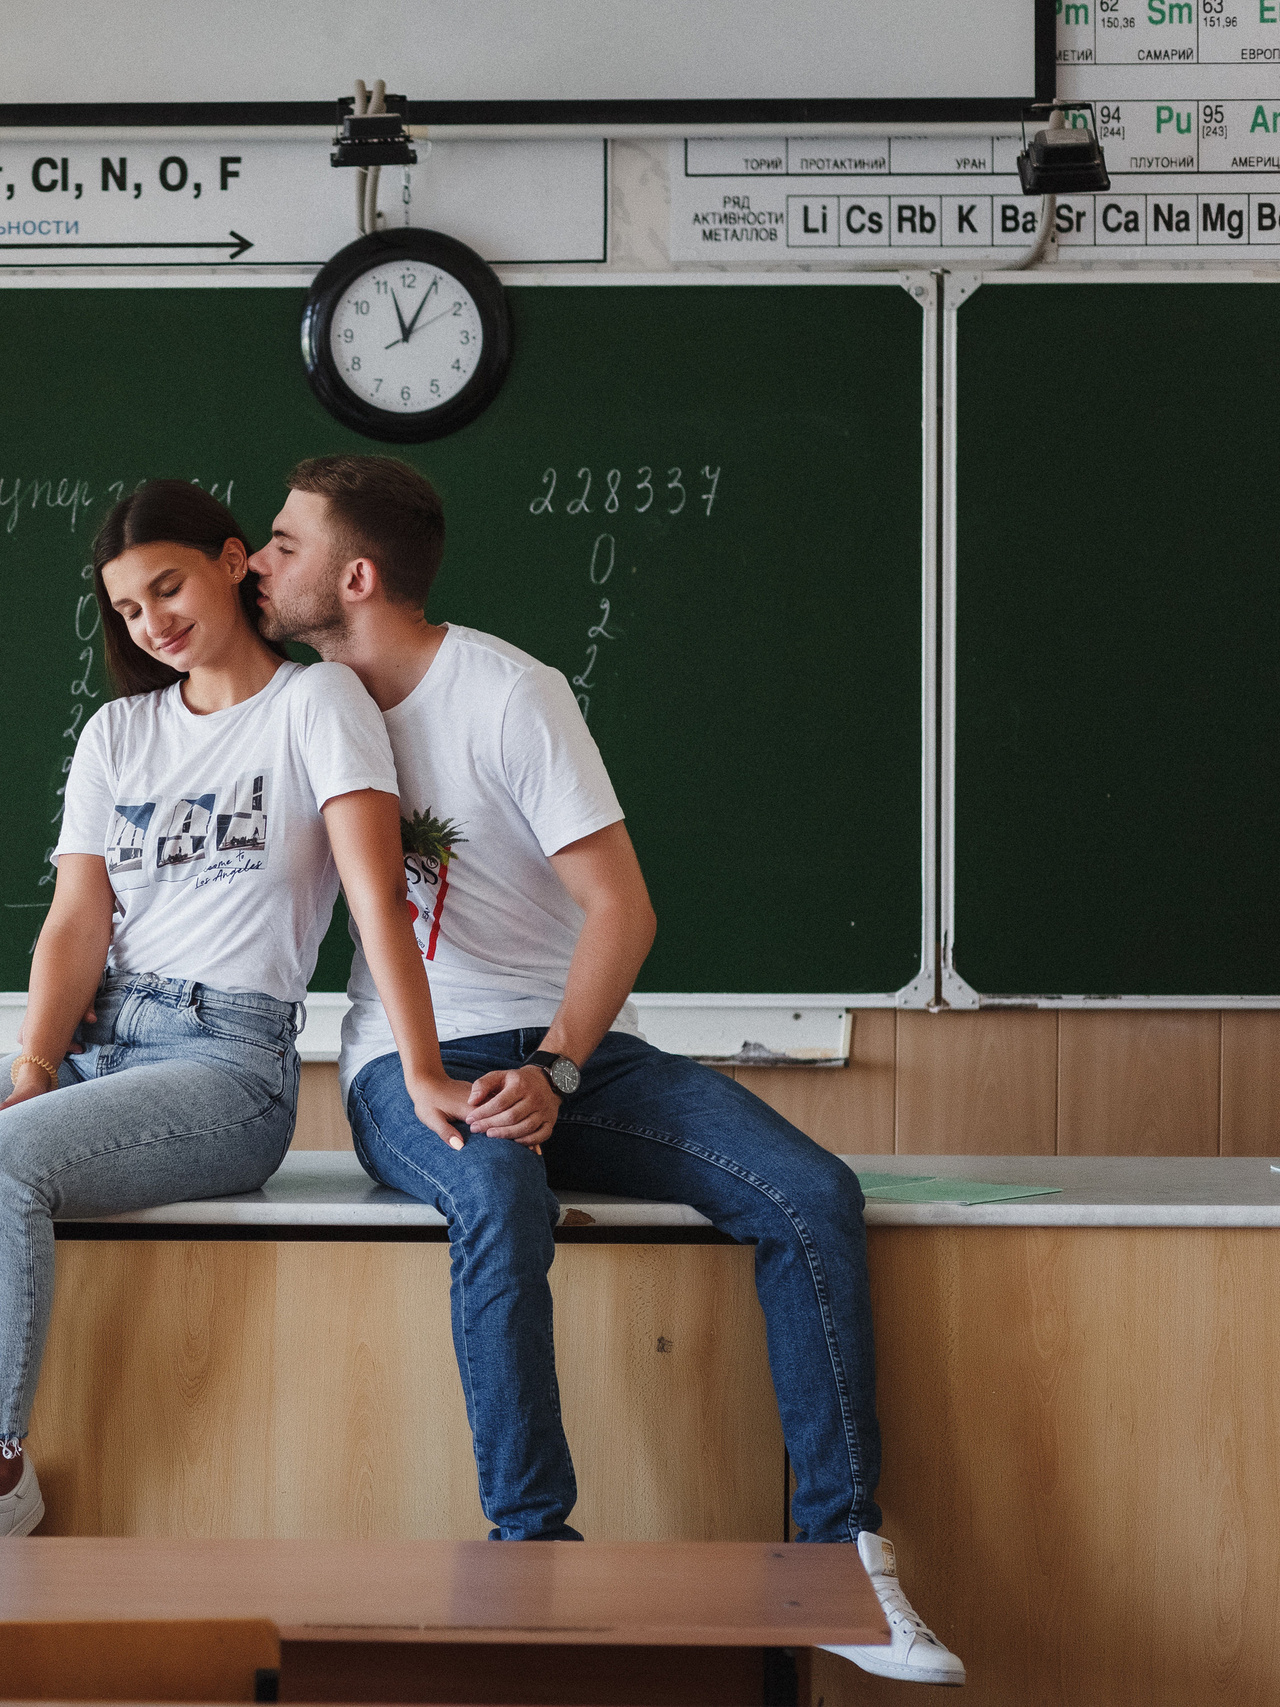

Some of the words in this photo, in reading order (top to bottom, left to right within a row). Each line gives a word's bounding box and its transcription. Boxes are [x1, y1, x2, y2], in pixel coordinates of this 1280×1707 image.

[1147, 0, 1193, 25] Sm
[1259, 0, 1280, 24] E
[1101, 17, 1136, 29] 150,36
[1204, 16, 1238, 29] 151,96
[1137, 48, 1194, 61] САМАРИЙ
[1100, 105, 1122, 124] 94
[1155, 105, 1192, 134] Pu
[1203, 104, 1225, 124] 95
[744, 156, 783, 170] ТОРИЙ
[800, 155, 887, 170] ПРОТАКТИНИЙ
[955, 156, 987, 170] УРАН
[1129, 154, 1195, 169] ПЛУТОНИЙ
[31, 157, 84, 200] Cl,
[101, 156, 143, 200] N,
[158, 156, 202, 200] O,
[219, 156, 242, 191] F
[723, 196, 751, 210] РЯД
[693, 211, 785, 226] АКТИВНОСТИ
[803, 204, 828, 233] Li
[845, 204, 884, 234] Cs
[897, 204, 937, 233] Rb
[957, 204, 978, 233] K
[1000, 203, 1038, 233] Ba
[1055, 203, 1086, 233] Sr
[1102, 203, 1140, 233] Ca
[1153, 203, 1190, 233] Na
[1202, 202, 1244, 239] Mg
[1257, 202, 1280, 231] B
[702, 227, 778, 242] МЕТАЛЛОВ
[373, 280, 389, 295] 11
[400, 273, 417, 289] 12
[353, 300, 370, 316] 10
[452, 301, 463, 317] 2
[343, 328, 354, 344] 9
[459, 330, 471, 346] 3
[350, 355, 362, 372] 8
[451, 358, 462, 373] 4
[373, 378, 384, 394] 7
[400, 386, 412, 401] 6
[430, 378, 441, 394] 5
[590, 533, 615, 585] 0
[587, 597, 616, 640] 2
[71, 646, 100, 698] 2
[572, 644, 597, 689] 2
[212, 859, 263, 884] Angeles
